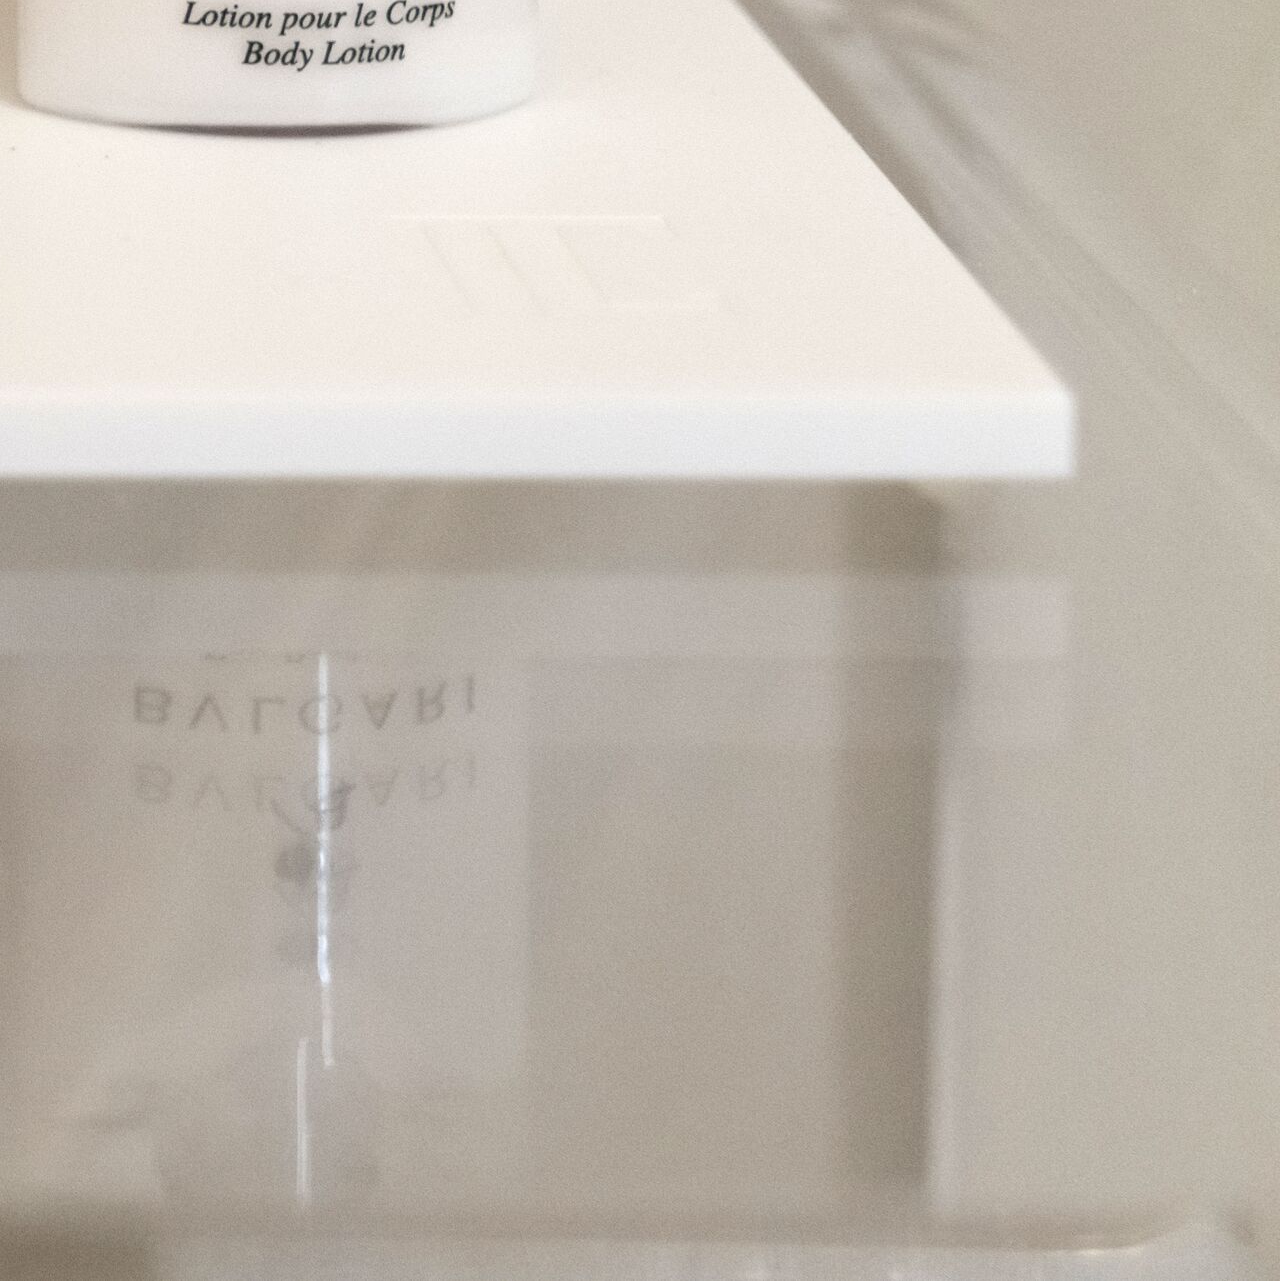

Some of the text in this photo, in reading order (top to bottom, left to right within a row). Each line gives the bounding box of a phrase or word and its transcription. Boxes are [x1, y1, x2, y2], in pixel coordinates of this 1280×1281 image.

[183, 0, 454, 37] Lotion pour le Corps
[243, 40, 405, 72] Body Lotion
